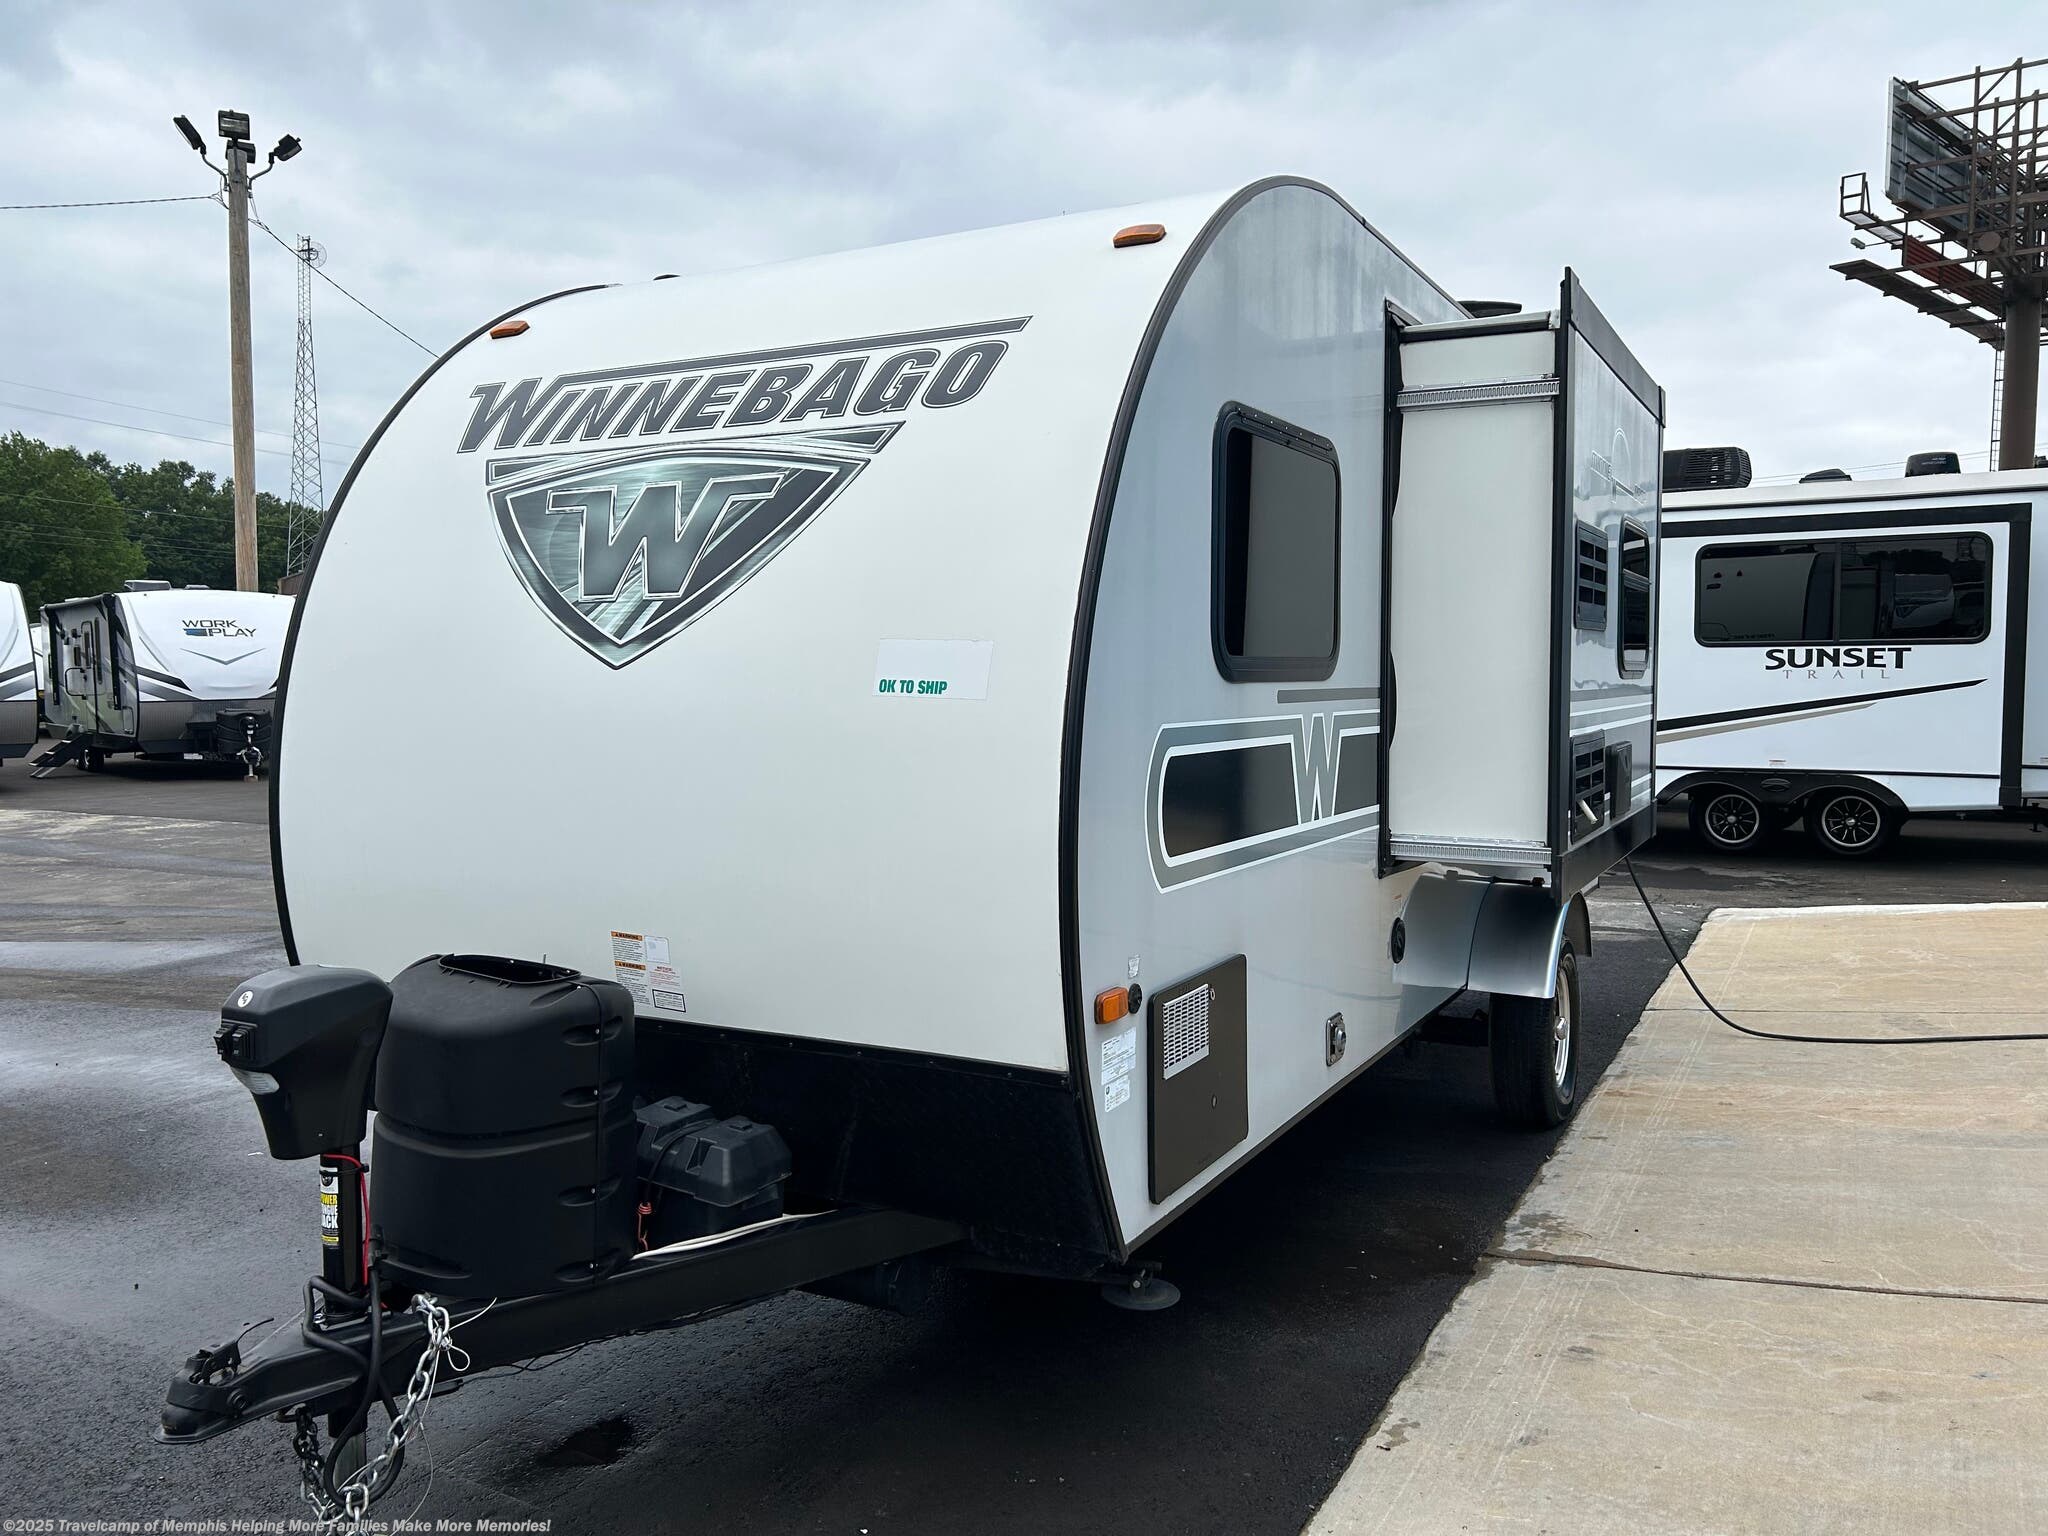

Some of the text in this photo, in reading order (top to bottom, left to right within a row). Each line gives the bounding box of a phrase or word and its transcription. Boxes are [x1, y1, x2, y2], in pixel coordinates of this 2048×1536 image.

[457, 339, 1009, 454] WINNEBAGO
[546, 472, 786, 602] W
[182, 619, 238, 628] WORK
[207, 628, 257, 637] PLAY
[1765, 647, 1912, 671] SUNSET
[1783, 669, 1890, 680] TRAIL
[879, 678, 948, 695] OK TO SHIP
